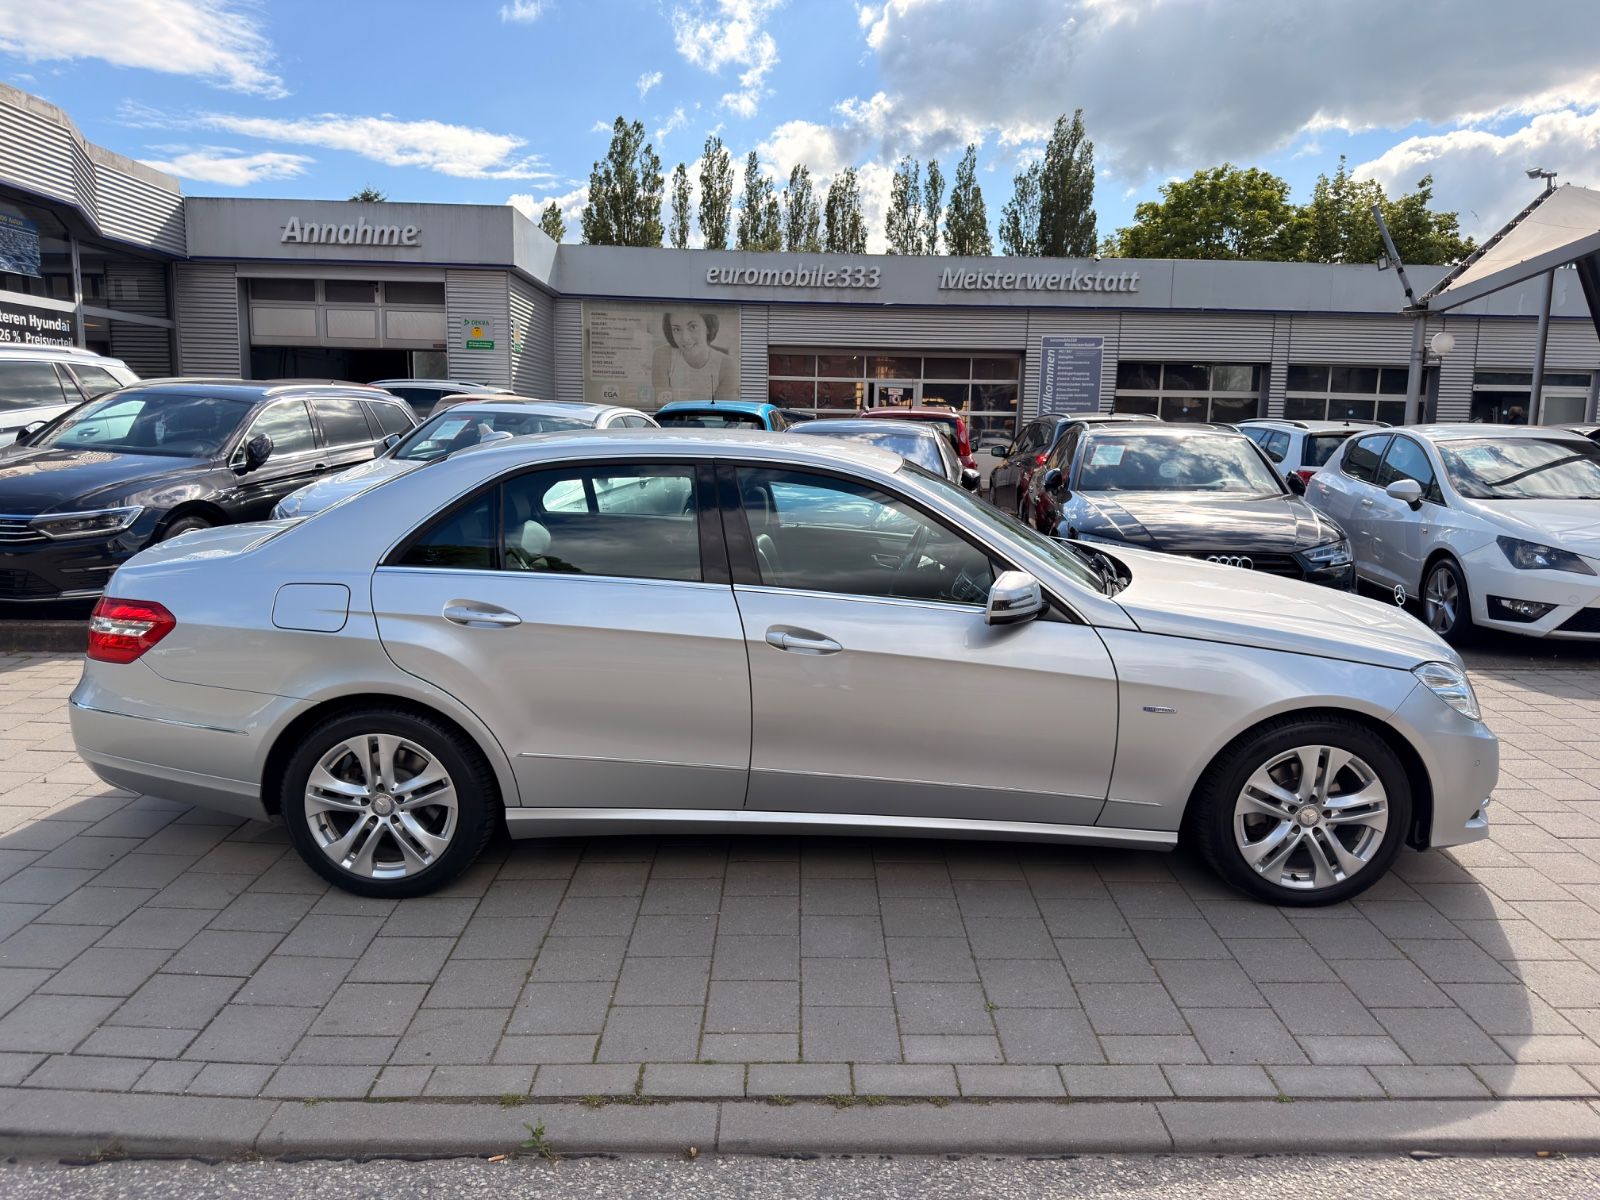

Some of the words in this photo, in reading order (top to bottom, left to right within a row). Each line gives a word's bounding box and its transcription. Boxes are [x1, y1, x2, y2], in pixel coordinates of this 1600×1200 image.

[281, 216, 418, 245] Annahme
[706, 264, 881, 288] euromobile333
[939, 267, 1140, 292] Meisterwerkstatt
[29, 314, 70, 332] Hyundai
[0, 328, 11, 341] 26
[12, 330, 21, 343] %
[25, 331, 74, 348] Preisvorteil
